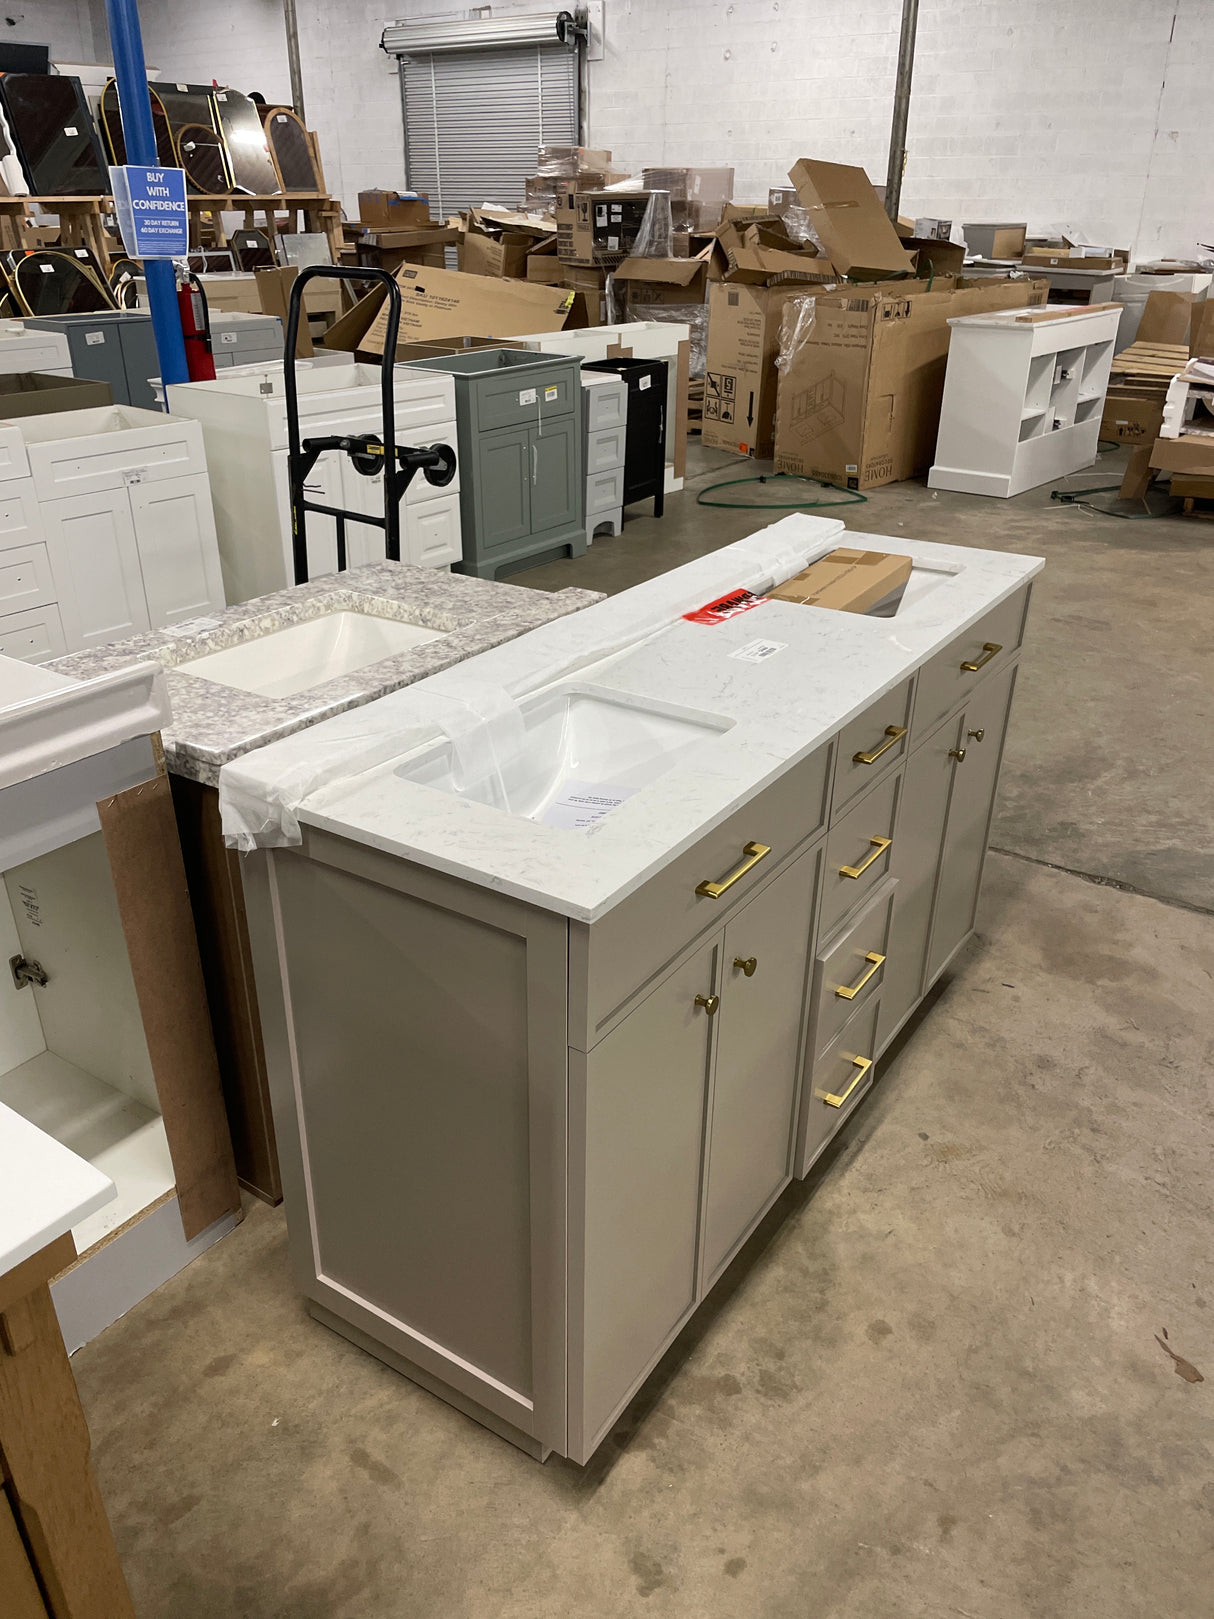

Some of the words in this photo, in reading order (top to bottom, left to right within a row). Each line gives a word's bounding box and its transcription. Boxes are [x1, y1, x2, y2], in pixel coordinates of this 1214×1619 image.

[146, 172, 165, 183] BUY
[146, 186, 170, 197] WITH
[132, 199, 185, 211] CONFIDENCE
[777, 459, 804, 473] HOME
[864, 464, 893, 482] HOME
